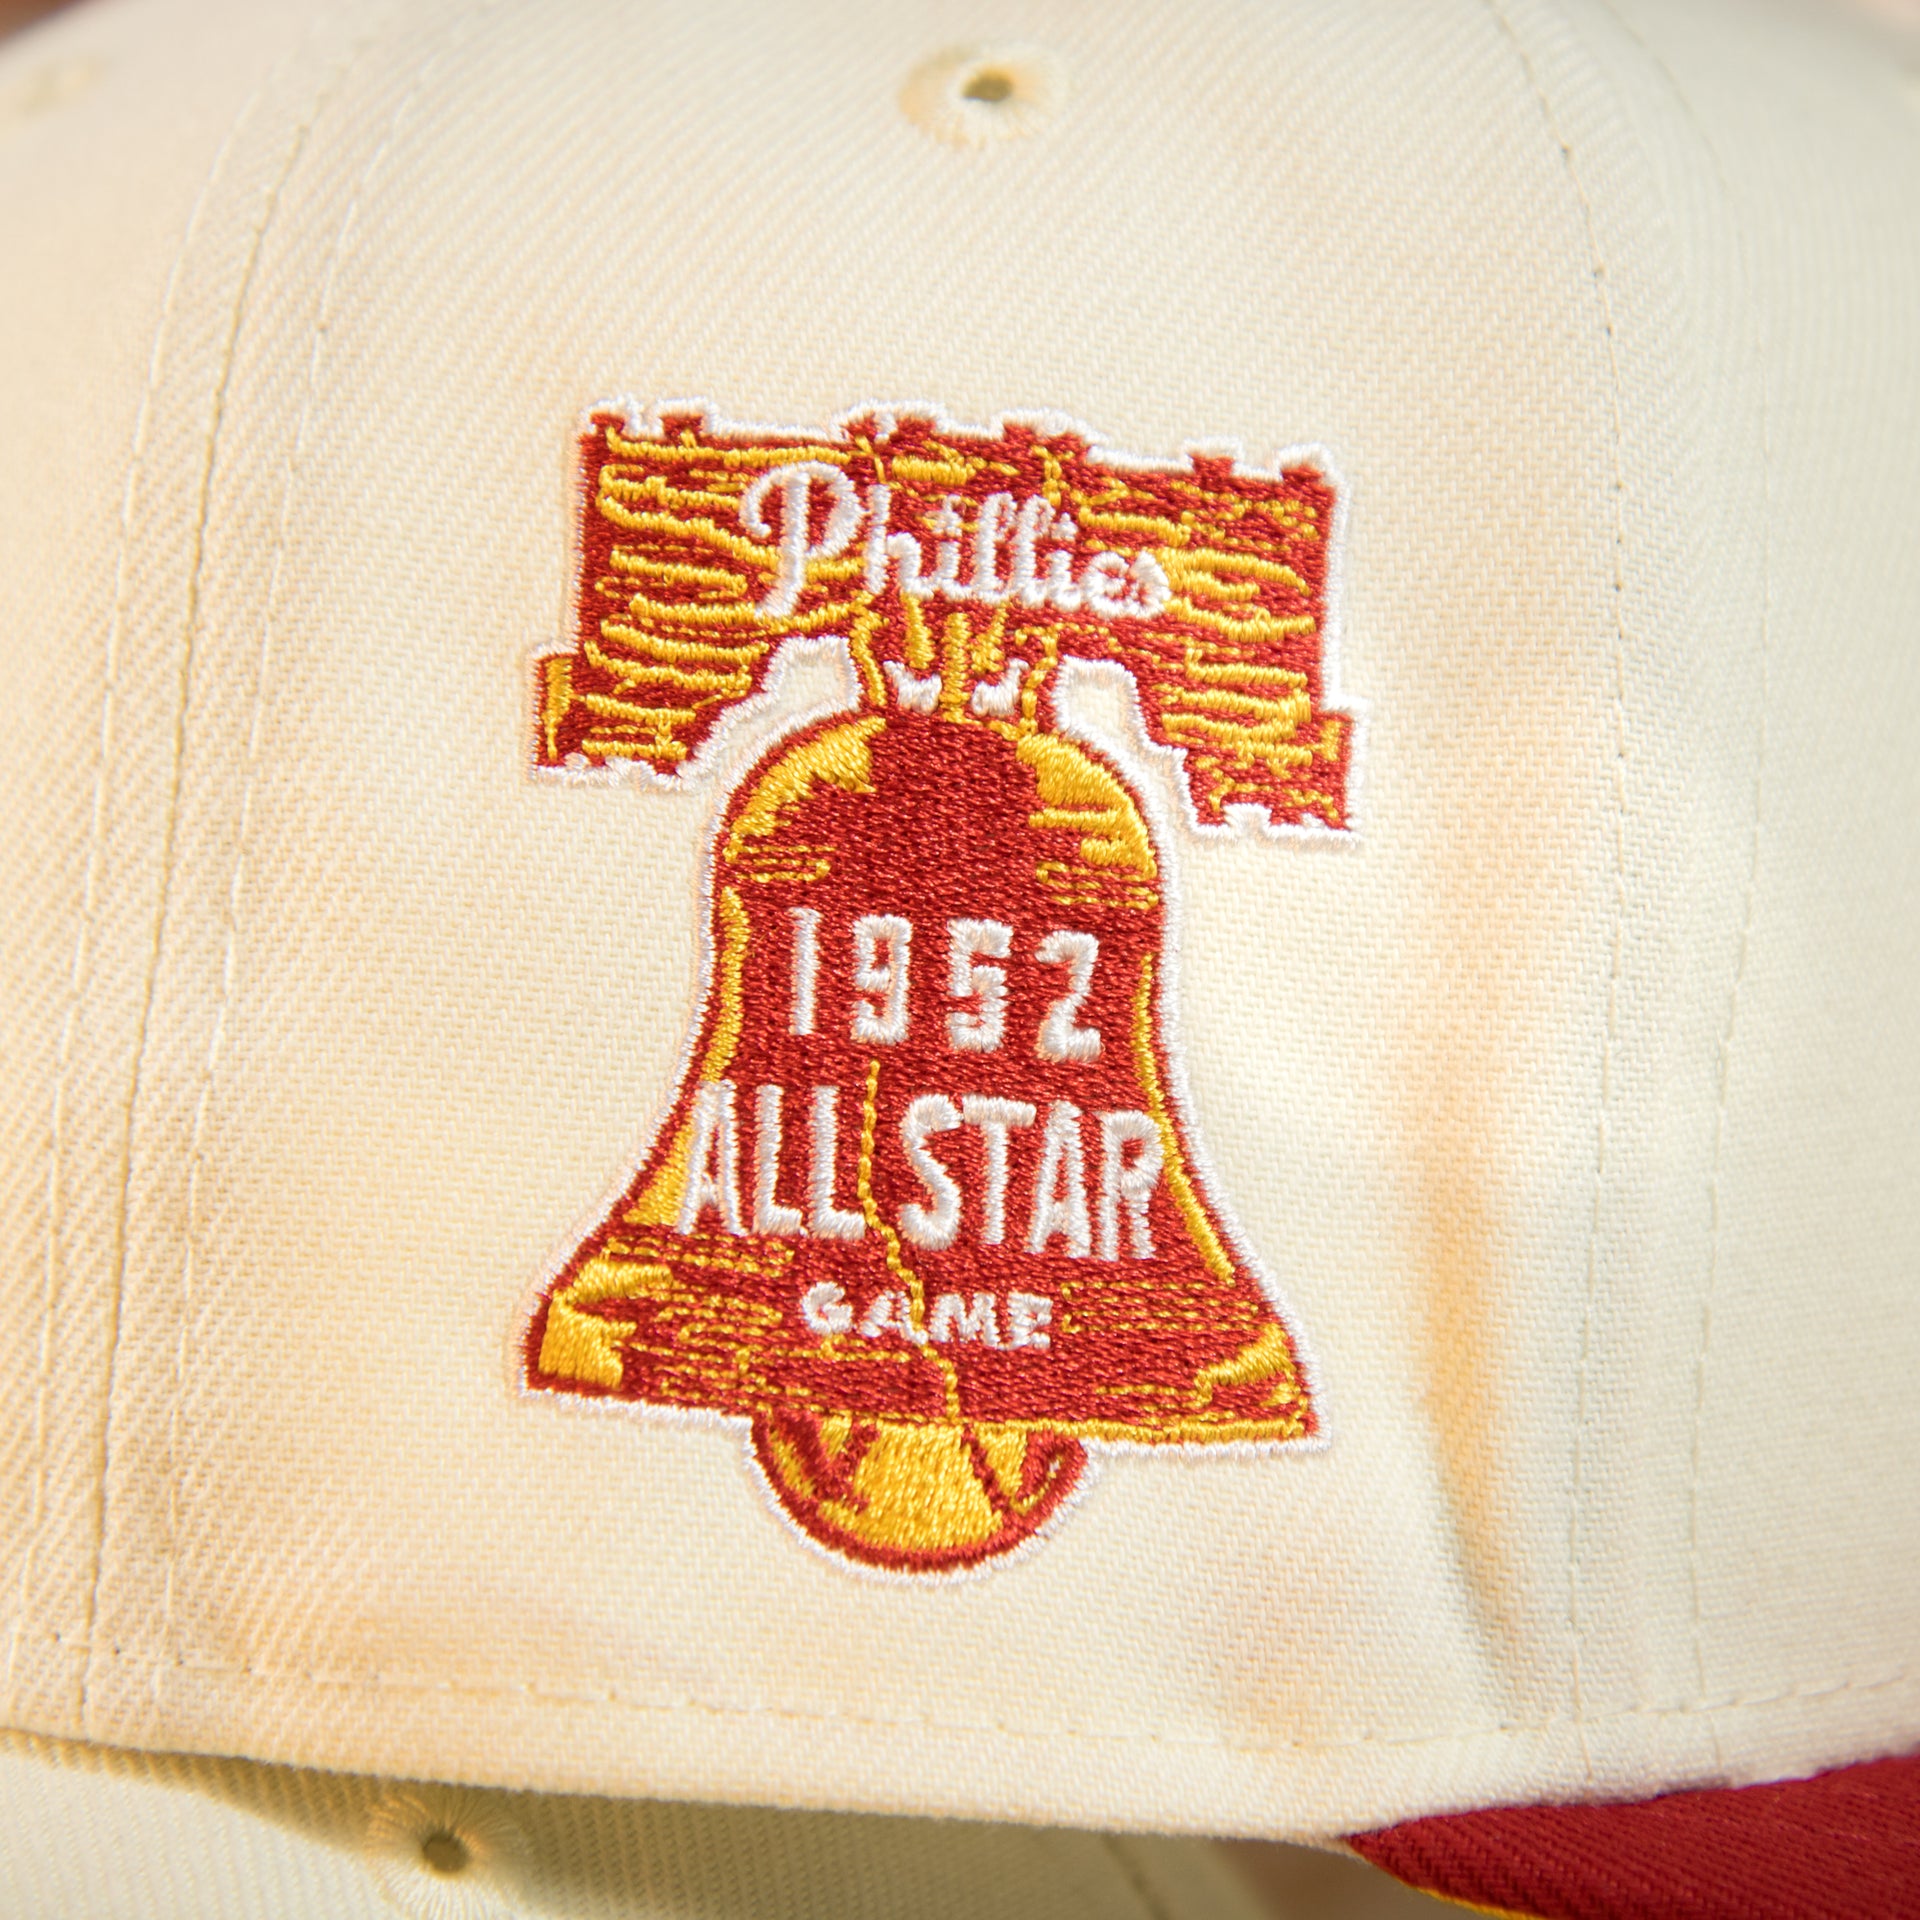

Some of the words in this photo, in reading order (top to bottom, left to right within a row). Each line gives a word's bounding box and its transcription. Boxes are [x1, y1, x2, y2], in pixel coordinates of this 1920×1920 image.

[740, 463, 1168, 620] Phillies
[788, 907, 1104, 1061] 1952
[676, 1081, 863, 1238] ALL
[899, 1094, 1165, 1261] STAR
[801, 1284, 1054, 1349] GAME
